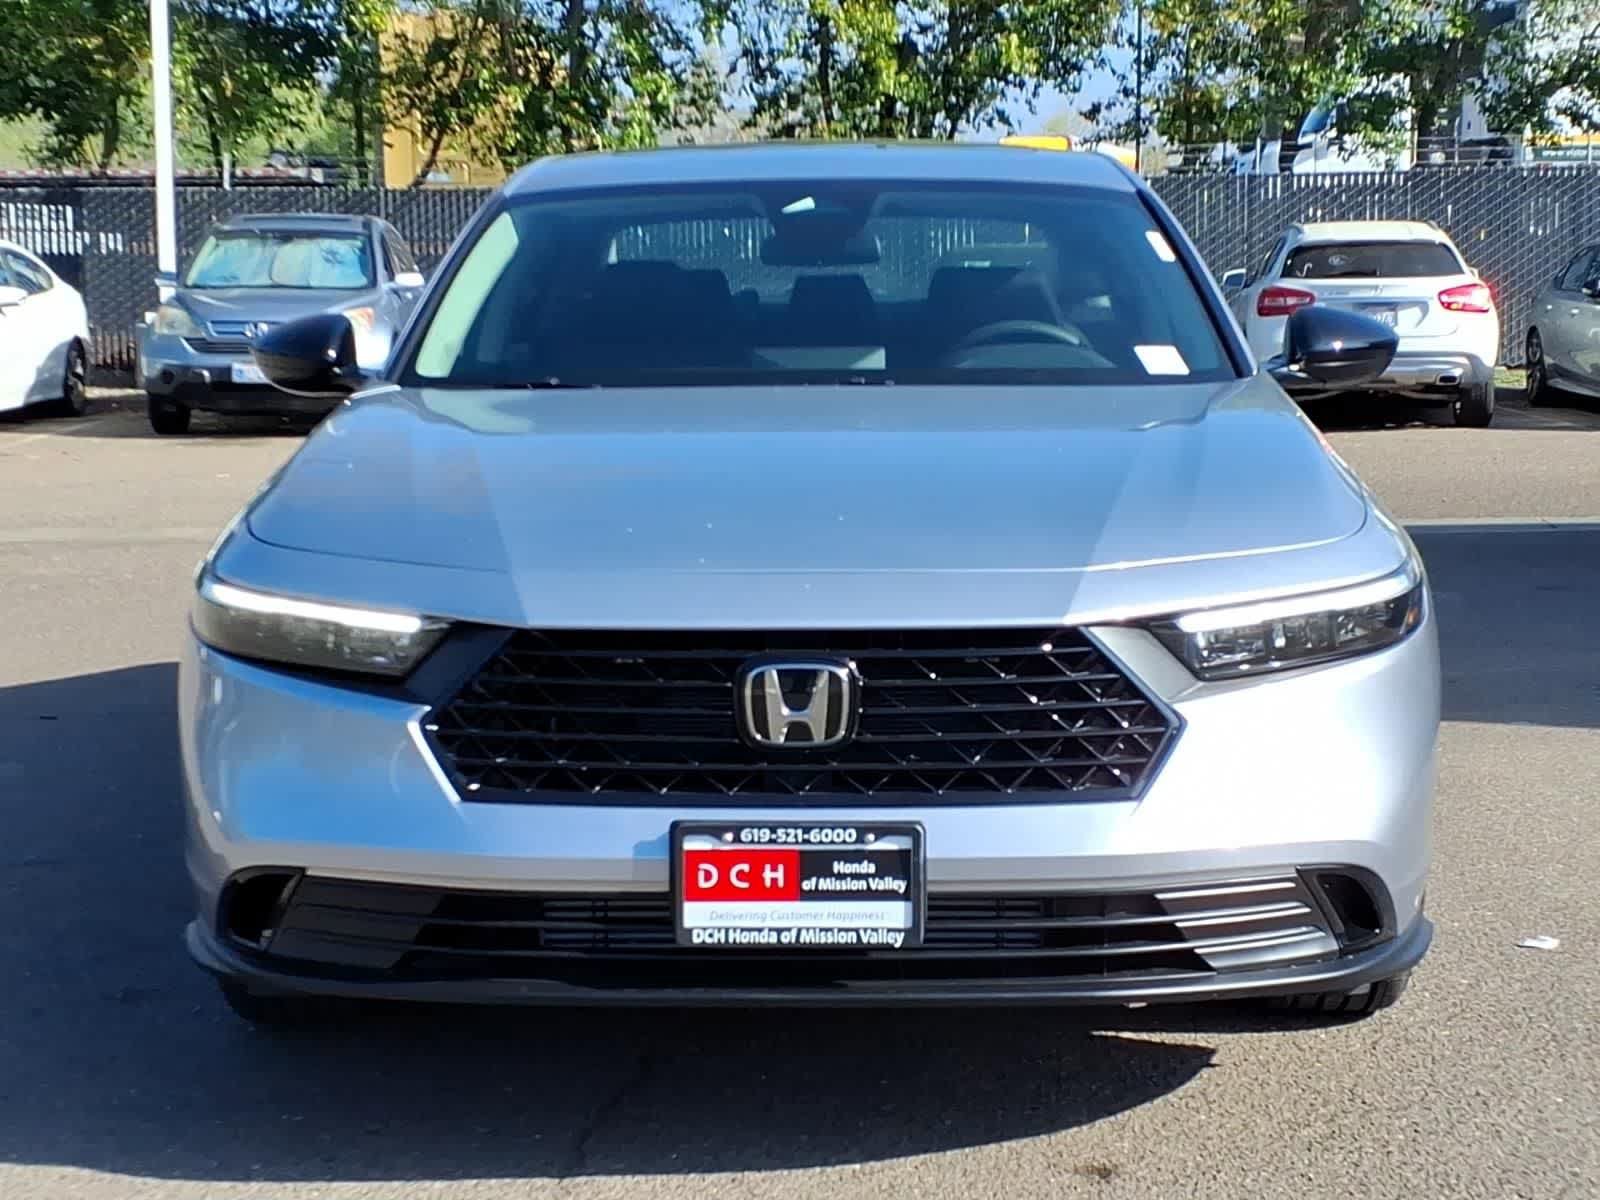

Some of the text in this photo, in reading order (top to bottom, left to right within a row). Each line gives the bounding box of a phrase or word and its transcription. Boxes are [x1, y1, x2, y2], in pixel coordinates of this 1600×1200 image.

[740, 828, 857, 843] 619-521-6000
[833, 860, 876, 875] Honda
[801, 876, 908, 894] of Mission Valley
[709, 910, 767, 922] Delivering
[770, 910, 824, 921] Customer
[692, 928, 905, 948] DCH Honda of Mission Valley
